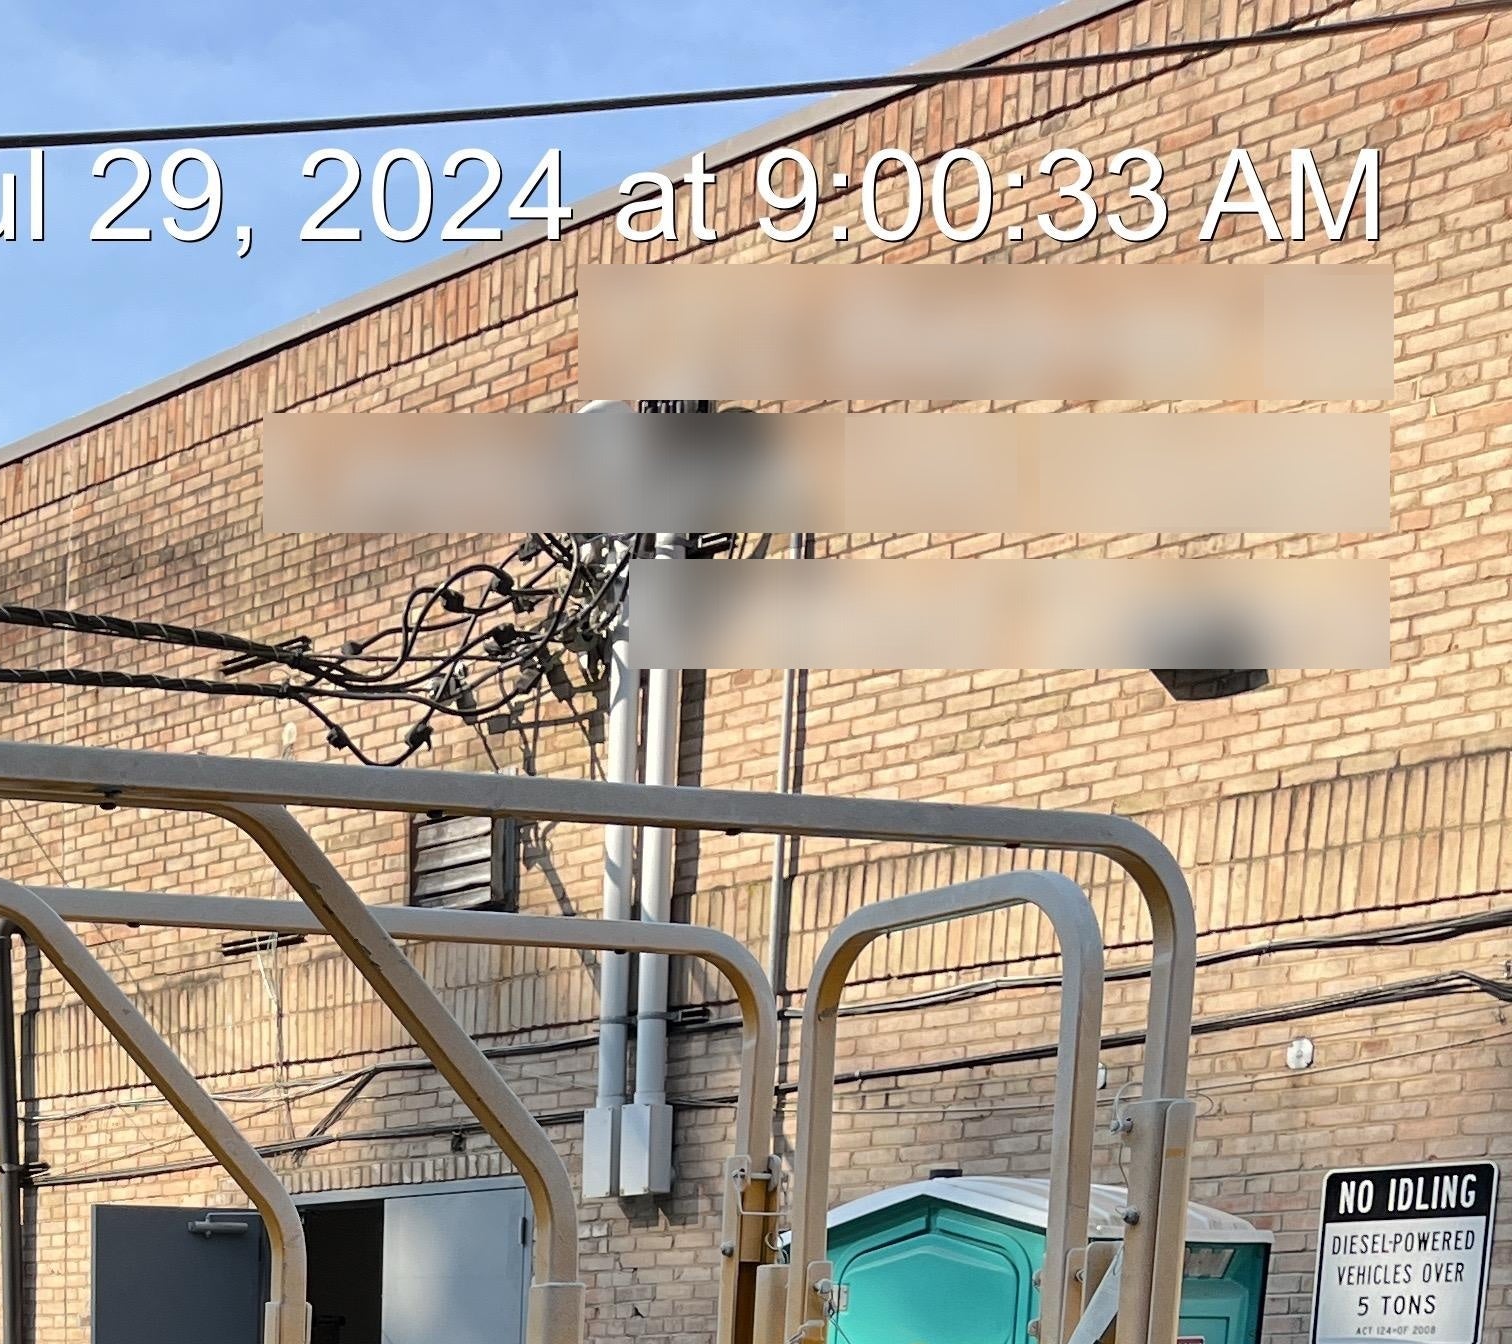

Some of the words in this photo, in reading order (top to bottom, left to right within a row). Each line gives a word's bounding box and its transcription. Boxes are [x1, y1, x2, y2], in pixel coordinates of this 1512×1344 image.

[1339, 1180, 1374, 1215] NO
[1387, 1173, 1477, 1212] IDLING
[1337, 1264, 1413, 1286] VEHICLES
[1422, 1262, 1465, 1284] OVER
[1357, 1296, 1369, 1317] 5
[1381, 1295, 1437, 1316] TONS
[1355, 1326, 1372, 1335] ACT
